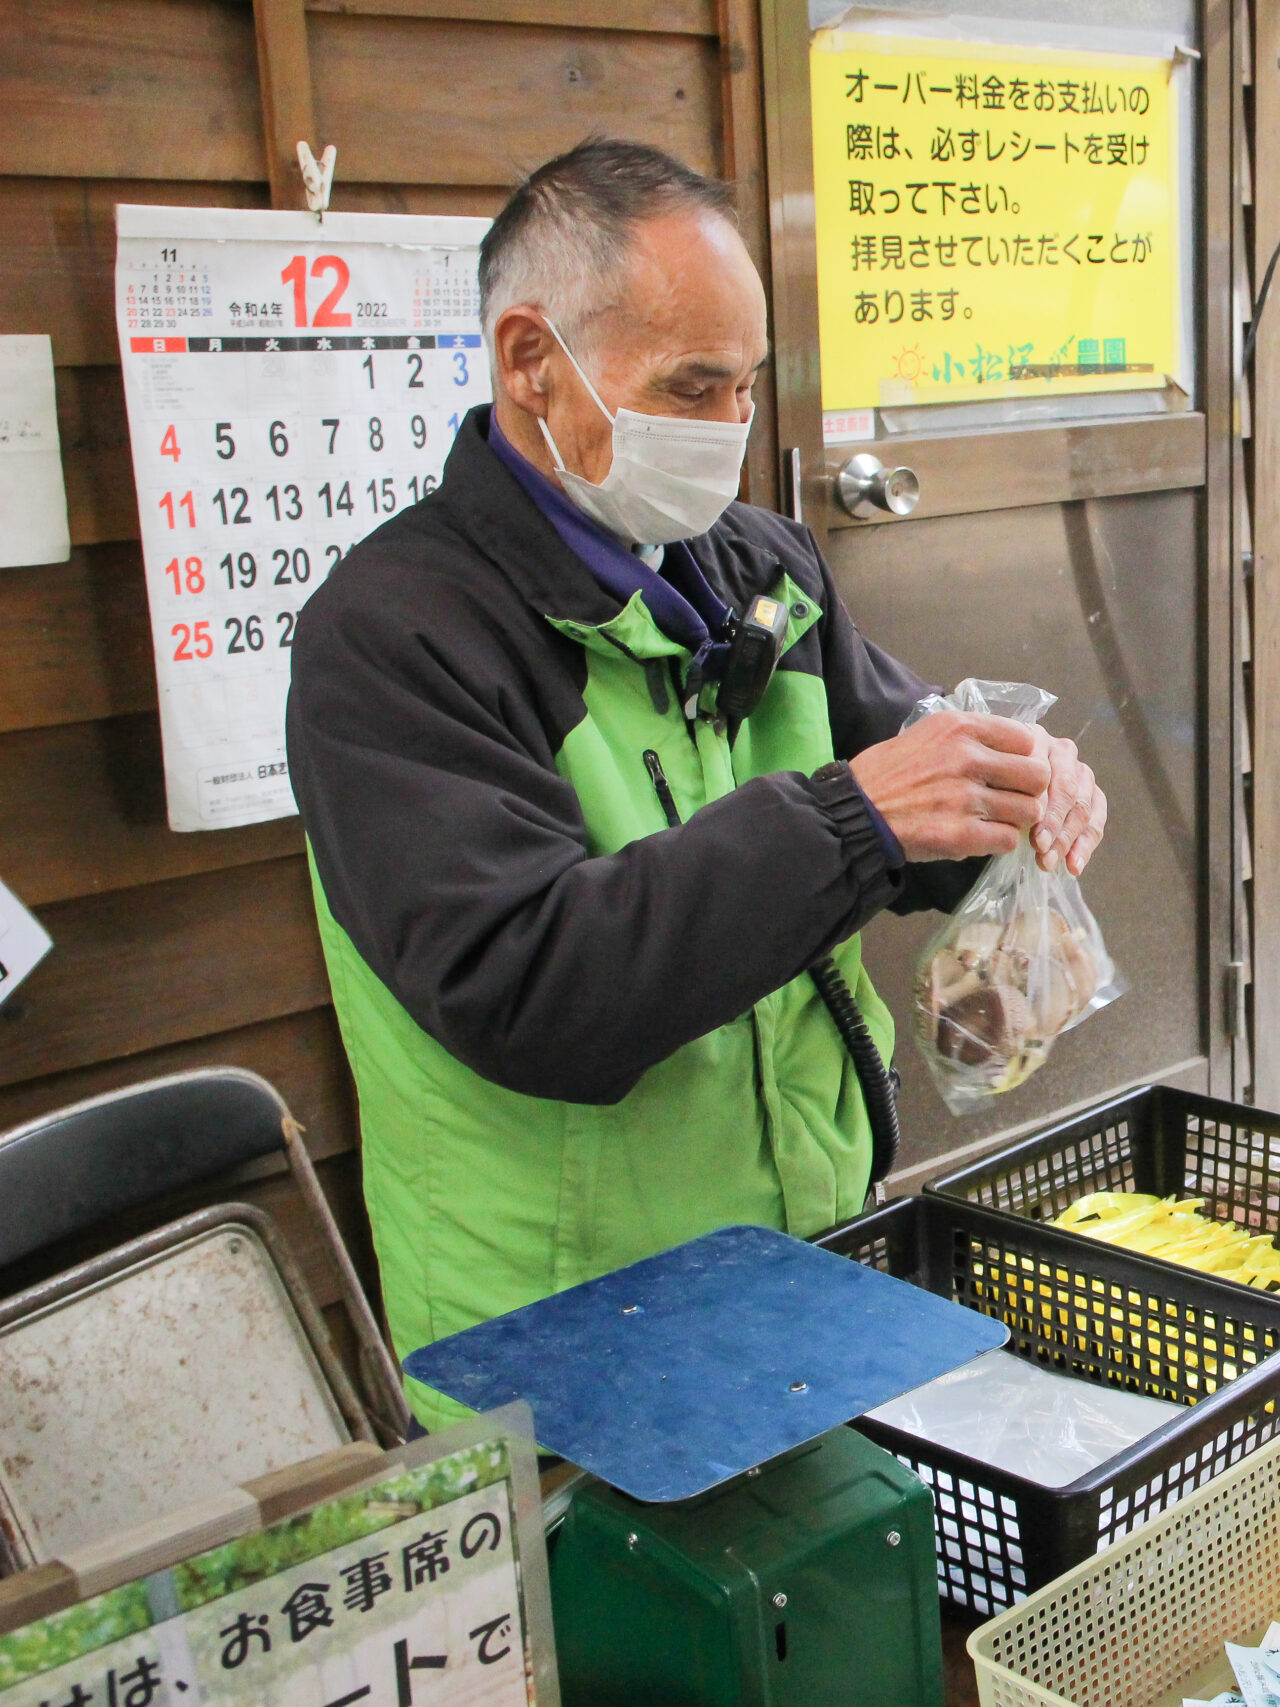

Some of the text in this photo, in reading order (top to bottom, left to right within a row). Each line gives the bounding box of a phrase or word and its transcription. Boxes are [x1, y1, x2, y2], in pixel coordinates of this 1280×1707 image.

[844, 69, 1150, 116] オーバー料金をお支払いの
[846, 124, 1150, 166] 際は、必ずレシートを受け
[848, 180, 1021, 217] 取って下さい。
[161, 248, 177, 262] 11
[851, 231, 1152, 272] 拝見させていただくことが
[229, 255, 388, 327] 令和4年 12 2022
[854, 287, 973, 324] あります。
[153, 339, 166, 352] 日
[208, 338, 222, 351] 月
[265, 338, 280, 351] 火
[317, 337, 332, 350] 水
[362, 336, 376, 350] 木
[453, 336, 466, 348] 土
[362, 354, 376, 389] 1
[406, 353, 424, 388] 2
[453, 352, 469, 387] 3
[160, 424, 181, 462] 4
[215, 422, 236, 460] 5
[269, 421, 289, 457] 6
[321, 418, 340, 454] 7
[369, 416, 384, 452] 8
[411, 415, 427, 449] 9
[159, 490, 197, 529] 11
[212, 487, 251, 525] 12
[266, 485, 303, 521] 13
[318, 480, 354, 518] 14
[366, 478, 396, 514] 15
[165, 556, 206, 595] 18
[220, 551, 257, 590] 19
[272, 547, 310, 585] 20
[171, 611, 300, 661] 25 26 2
